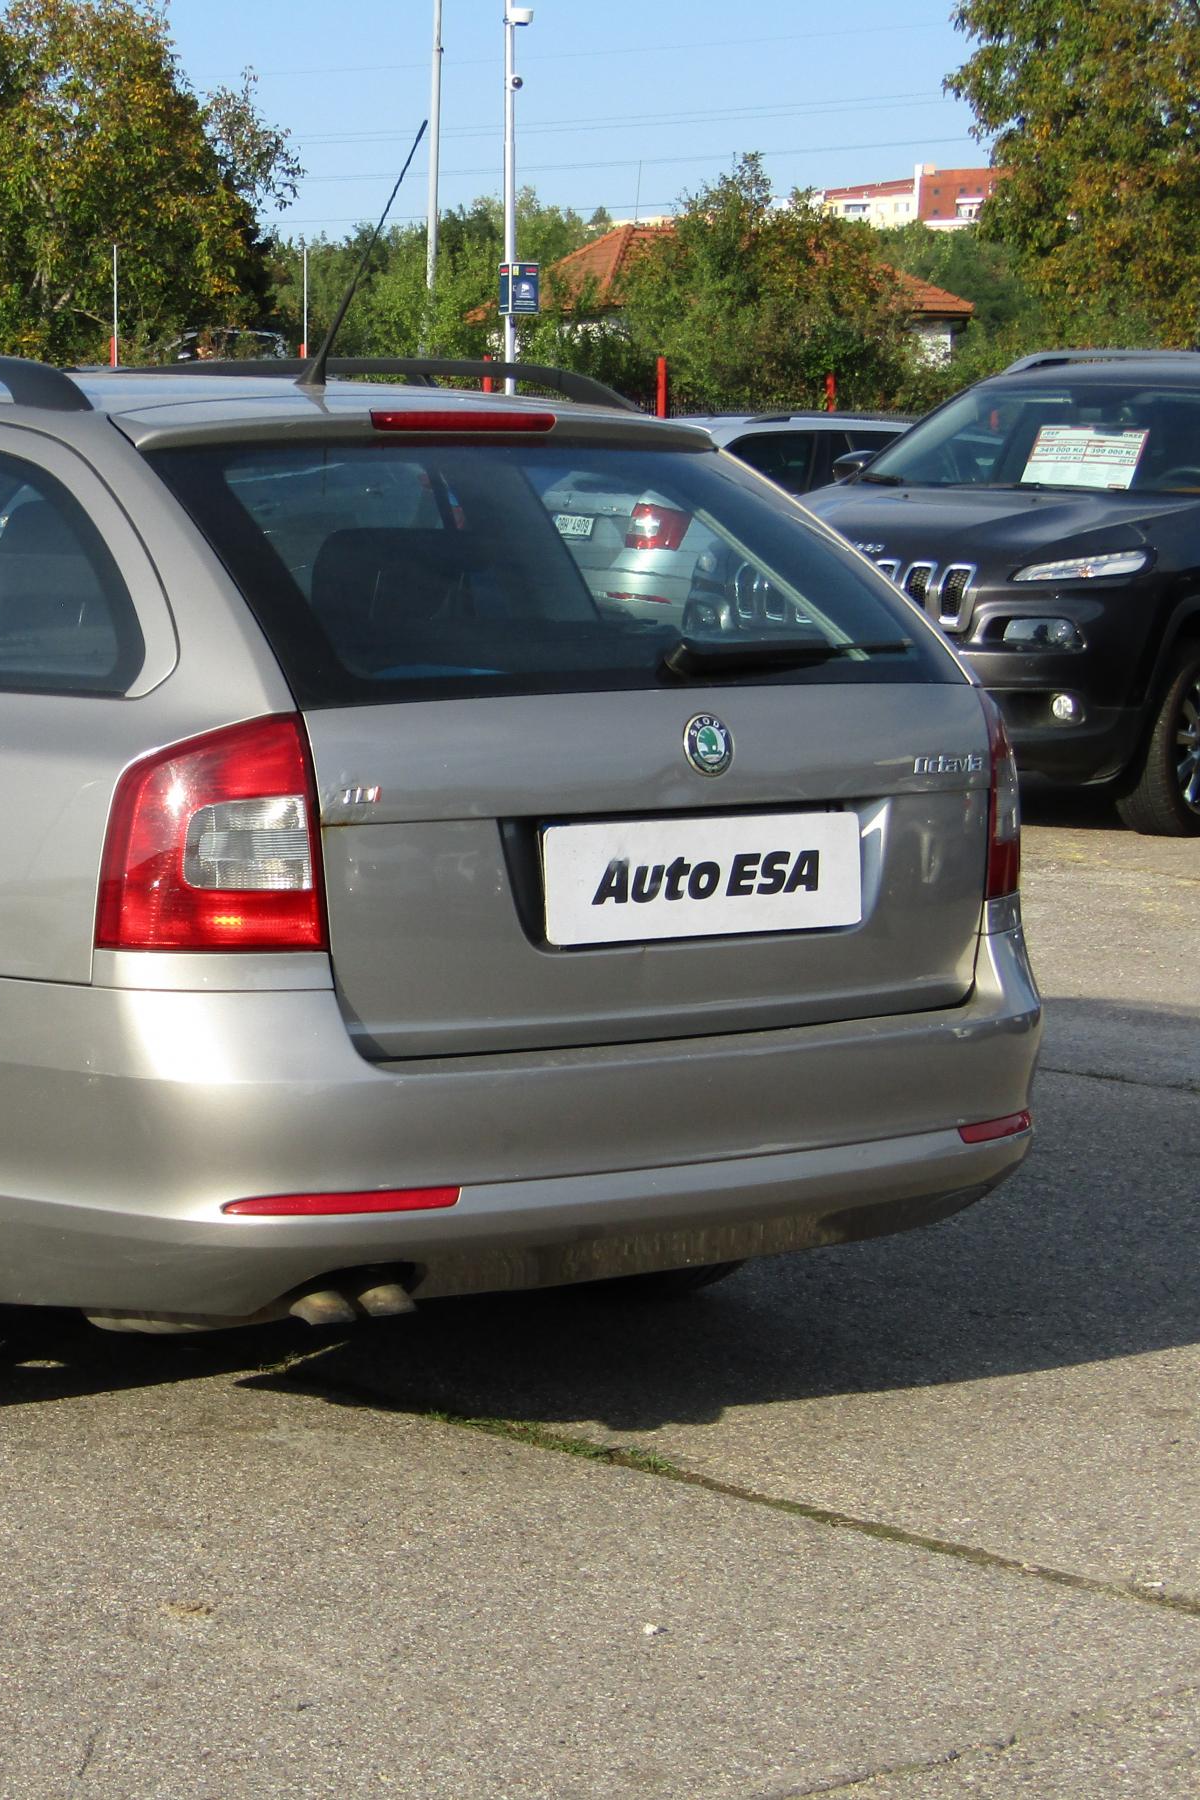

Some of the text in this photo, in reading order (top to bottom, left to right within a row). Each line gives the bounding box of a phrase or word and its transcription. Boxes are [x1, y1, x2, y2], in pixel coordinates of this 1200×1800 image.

[913, 753, 983, 774] Octavia
[341, 786, 382, 804] TDI
[591, 850, 820, 905] Auto ESA
